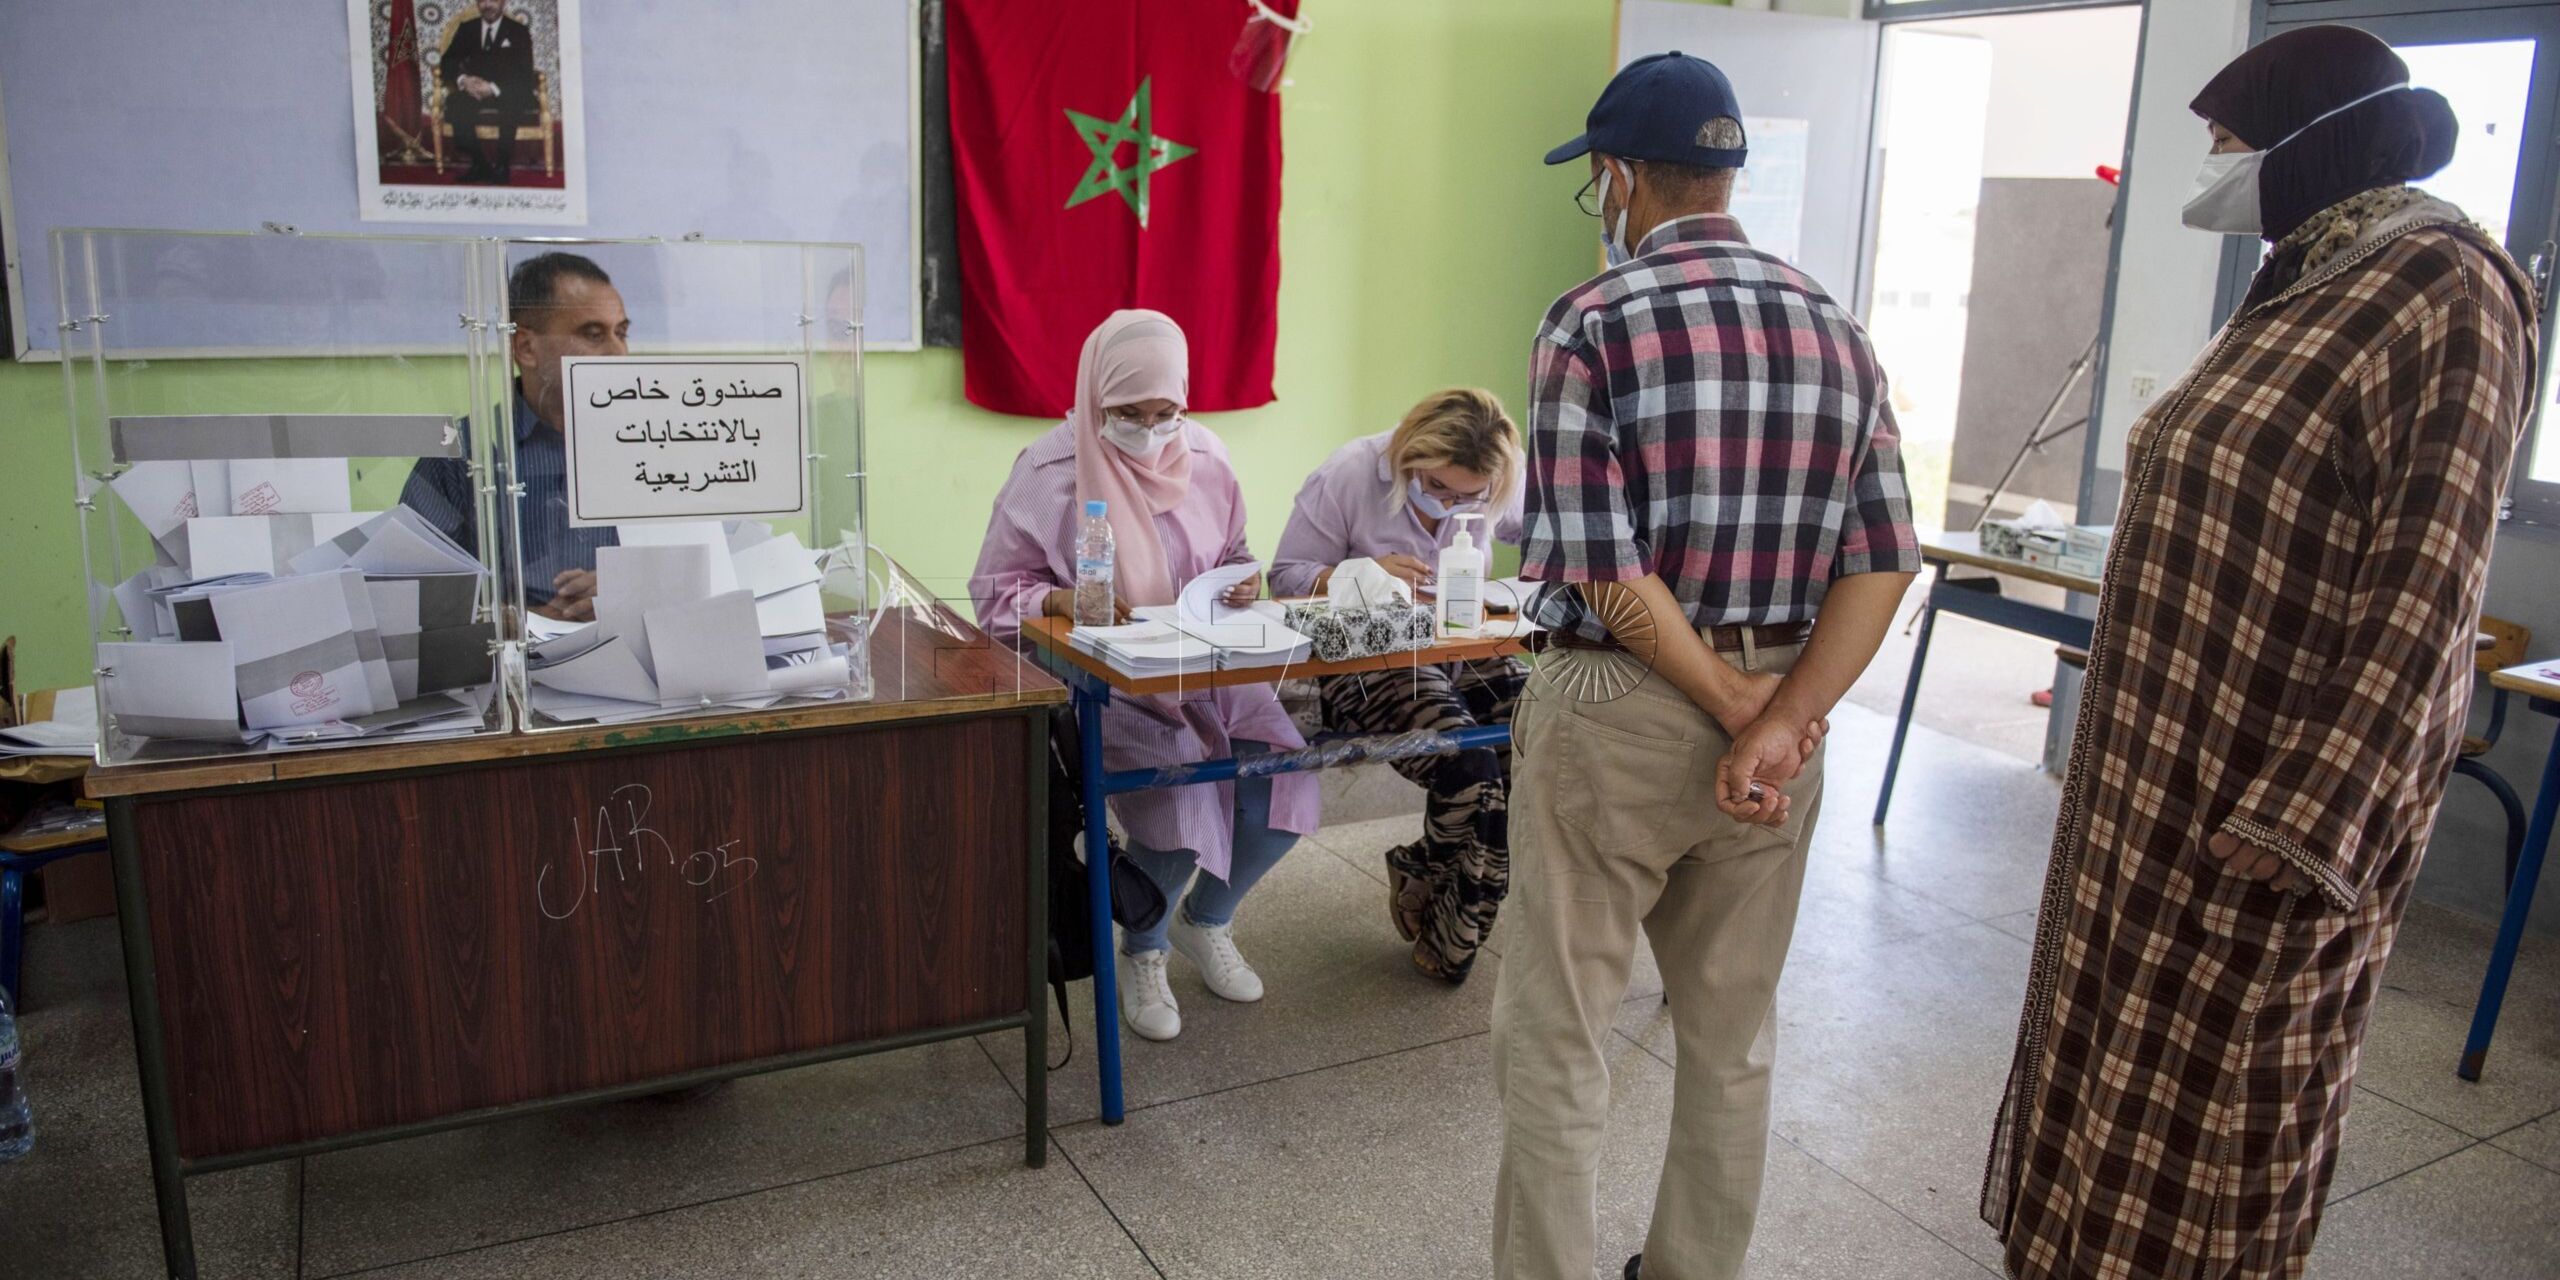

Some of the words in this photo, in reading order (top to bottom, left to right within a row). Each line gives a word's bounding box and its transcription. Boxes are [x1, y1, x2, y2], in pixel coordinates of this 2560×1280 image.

[590, 376, 670, 408] خاص
[681, 377, 782, 407] صندوق
[616, 418, 761, 449] بالانتخابات
[635, 459, 757, 492] التشريعية
[537, 783, 675, 920] JAR
[681, 839, 759, 903] 05
